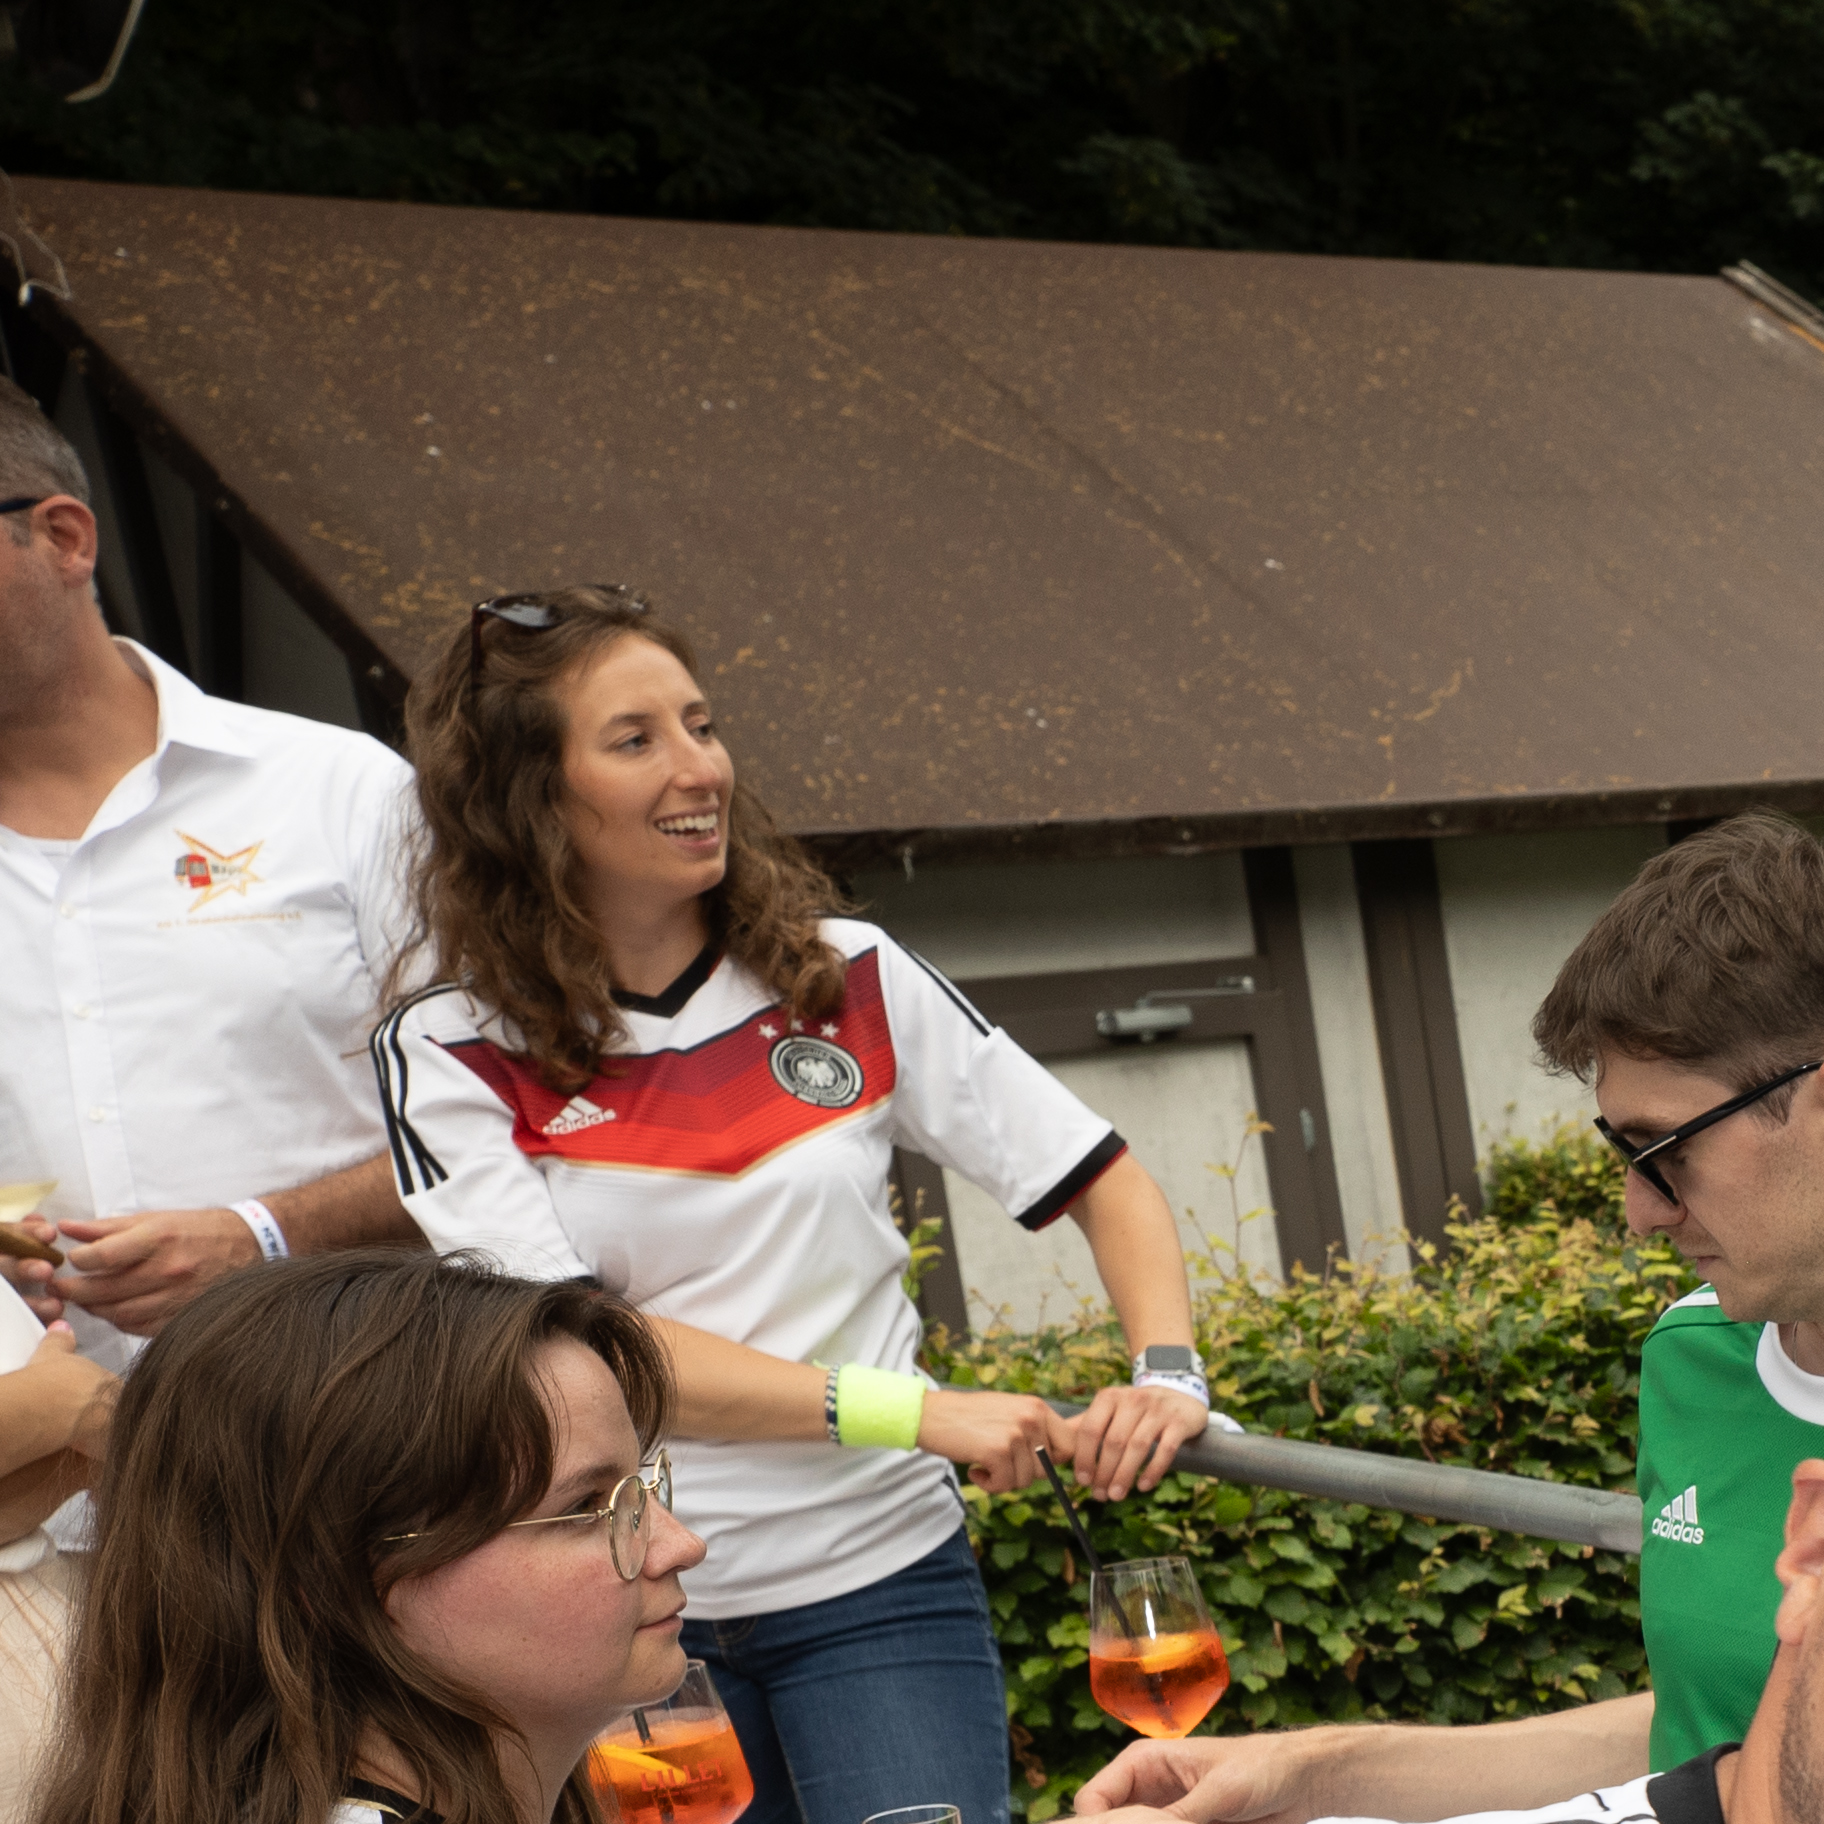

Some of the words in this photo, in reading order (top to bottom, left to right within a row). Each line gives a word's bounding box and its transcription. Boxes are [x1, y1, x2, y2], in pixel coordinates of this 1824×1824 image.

[541, 1108, 618, 1136] adidas
[1651, 1517, 1705, 1545] adidas
[640, 1758, 725, 1792] LILLET
